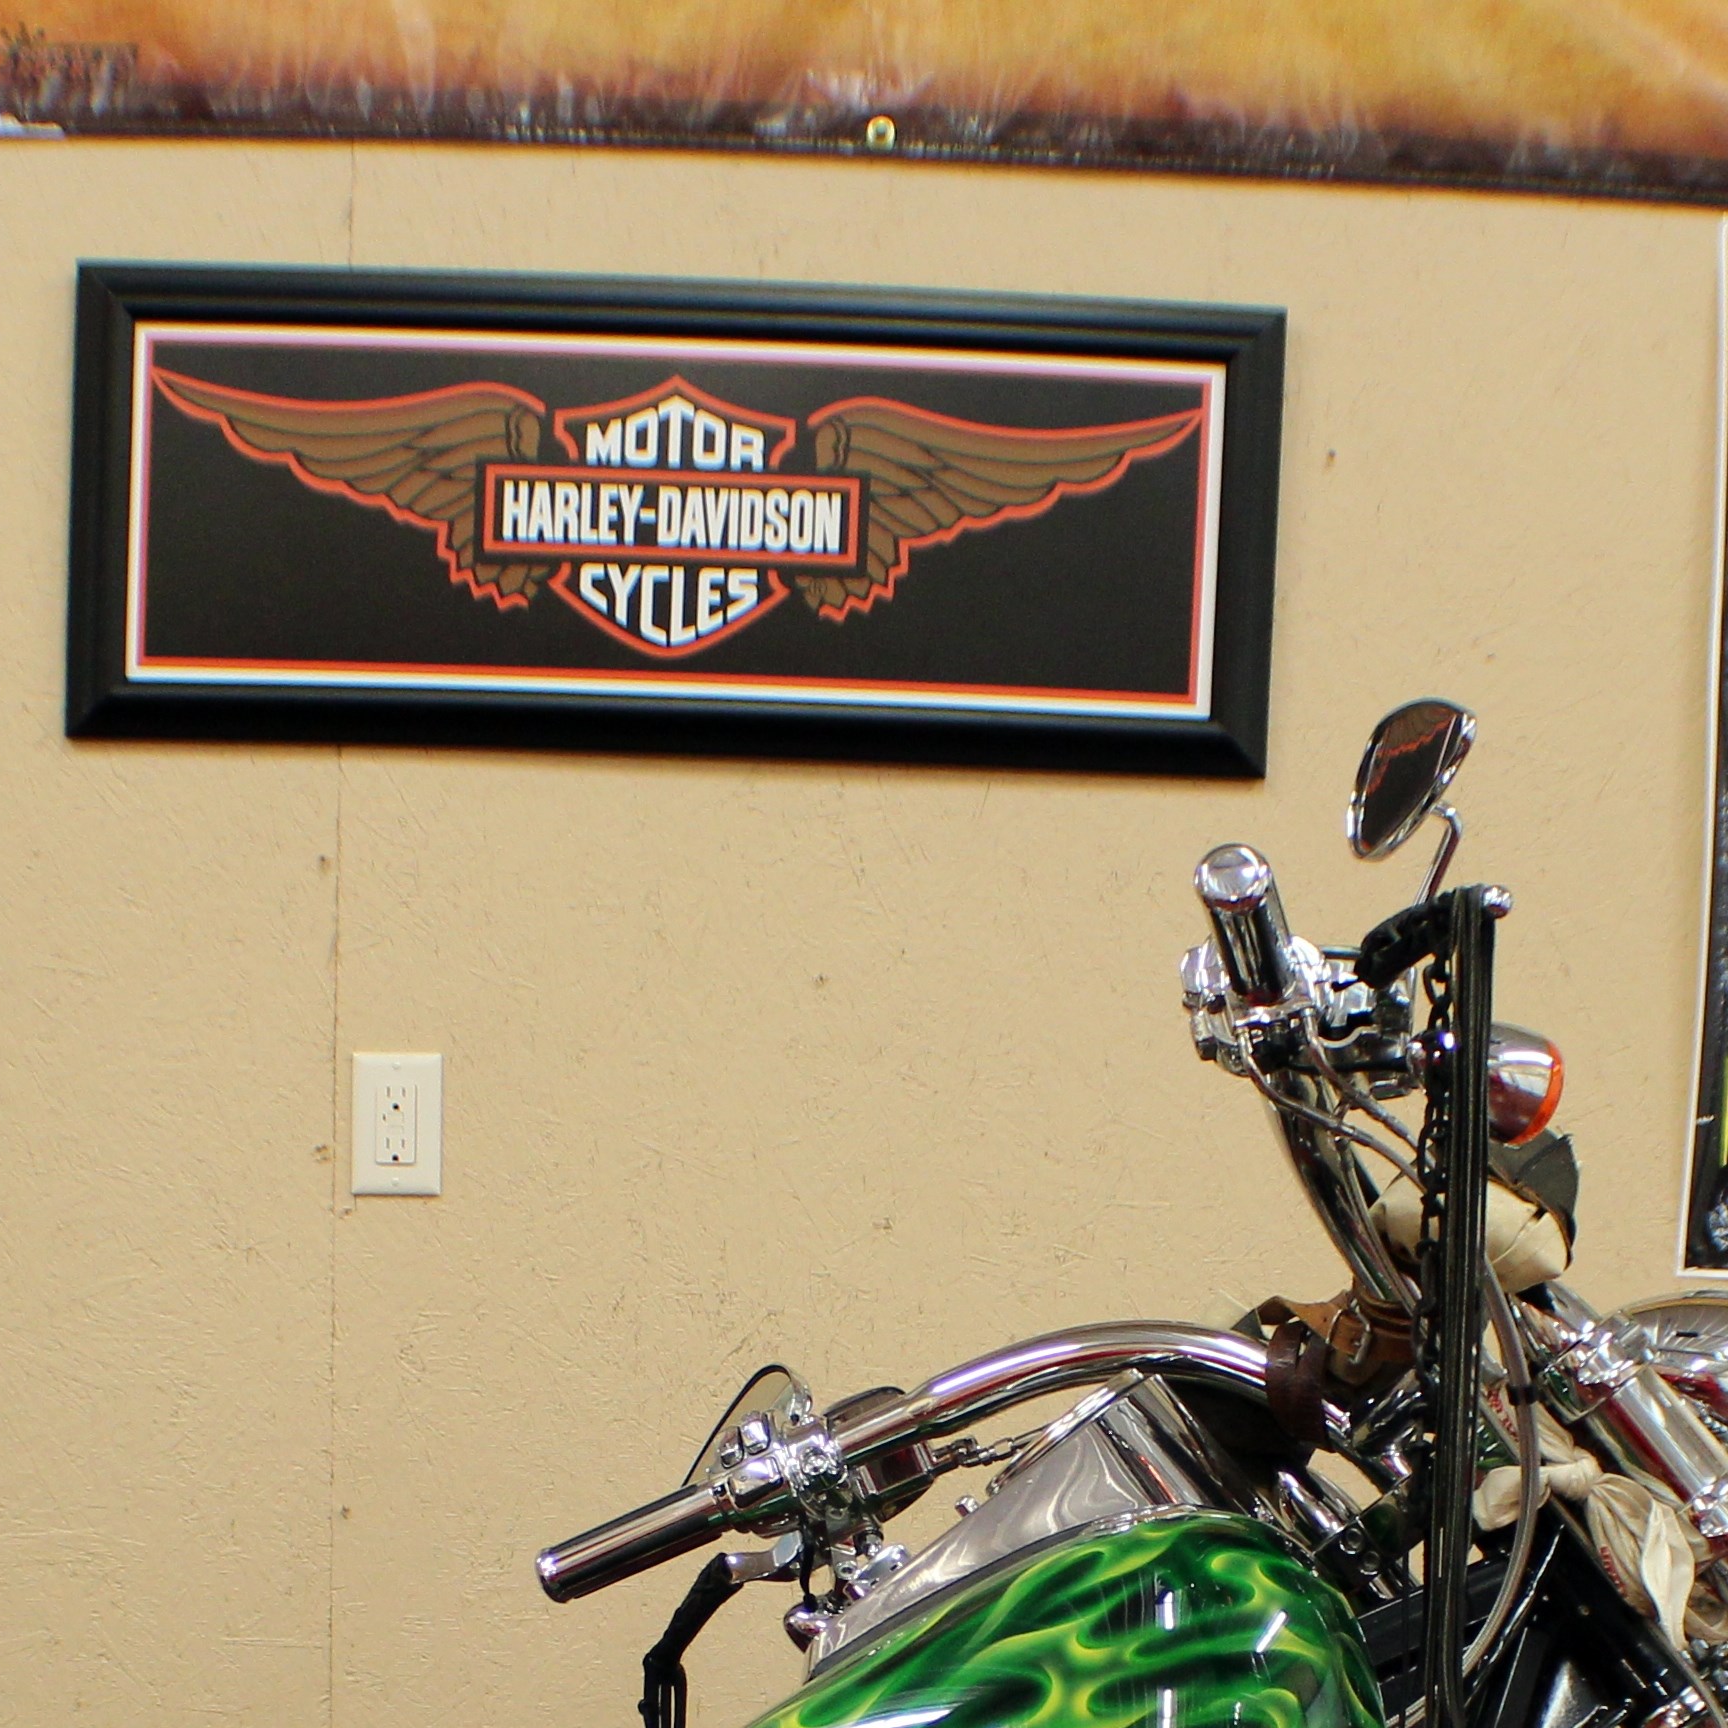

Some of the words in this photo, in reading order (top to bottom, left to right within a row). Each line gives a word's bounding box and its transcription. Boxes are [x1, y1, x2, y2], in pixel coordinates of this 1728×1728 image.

[585, 394, 765, 472] MOTOR
[501, 479, 843, 554] HARLEY-DAVIDSON
[579, 561, 760, 647] CYCLES
